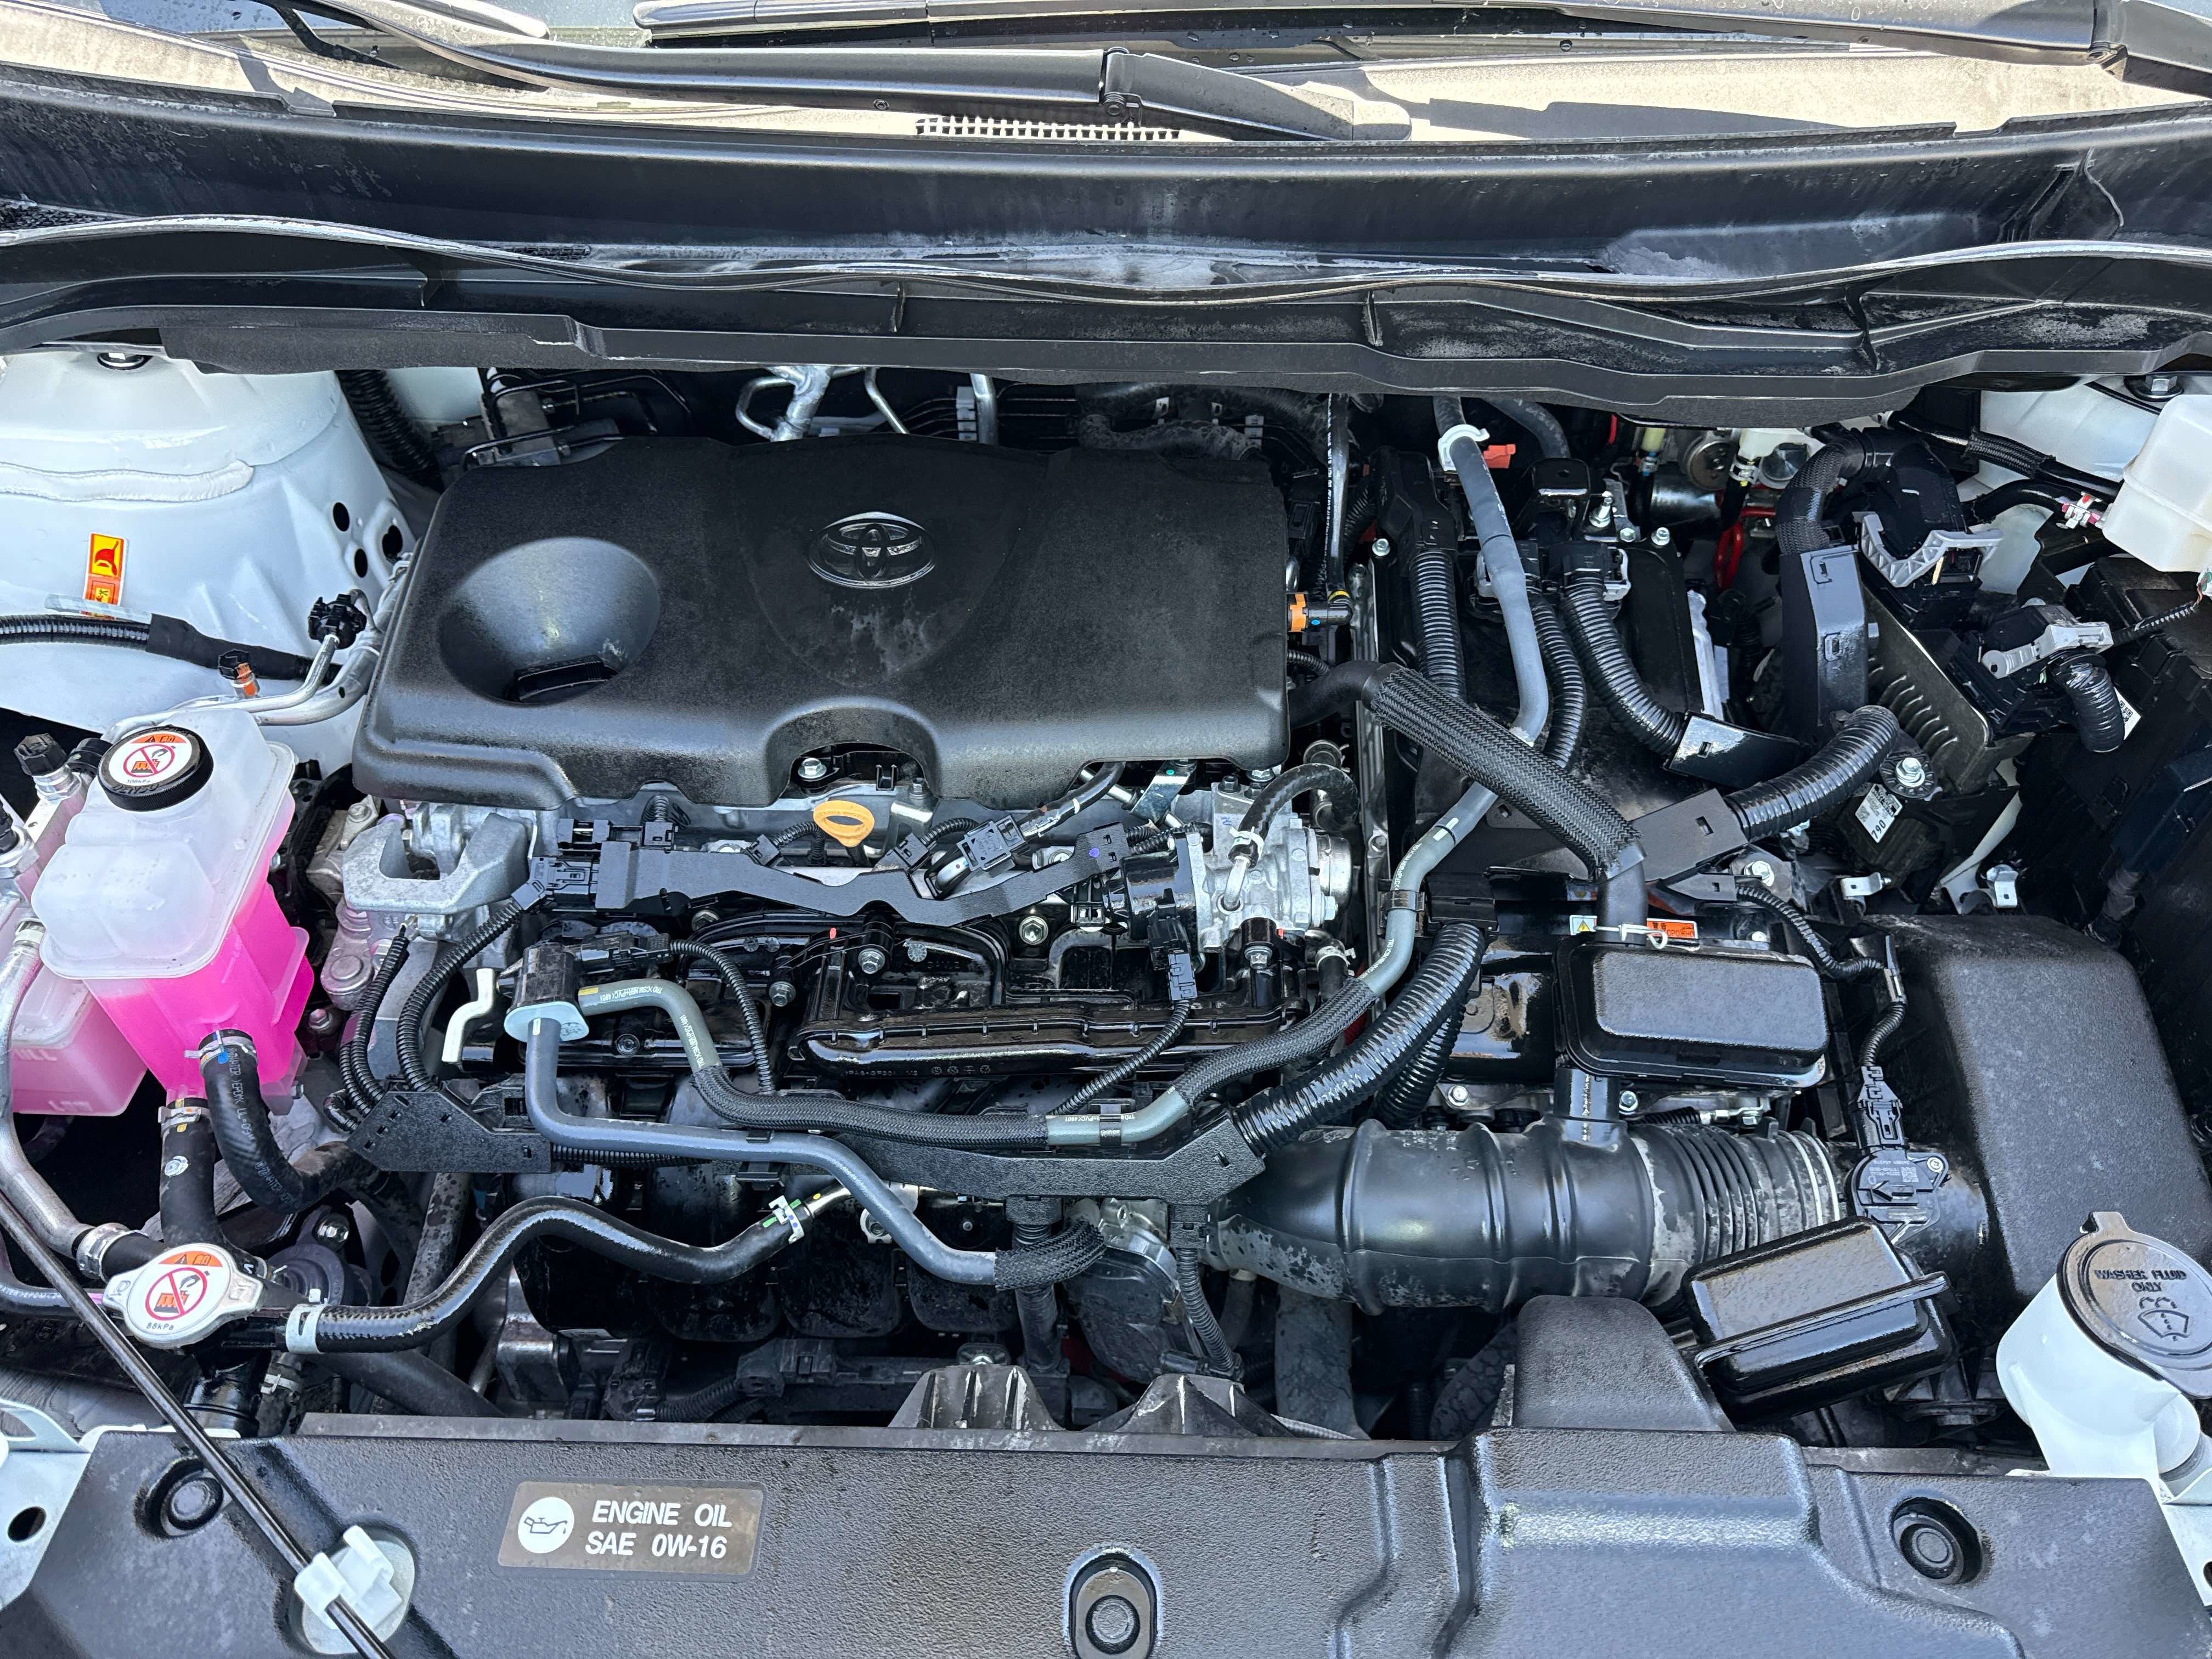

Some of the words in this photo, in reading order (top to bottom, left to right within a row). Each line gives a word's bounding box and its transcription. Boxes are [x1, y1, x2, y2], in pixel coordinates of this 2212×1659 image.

[112, 783, 159, 794] DENSO
[1871, 819, 1886, 839] 790
[2094, 1269, 2148, 1280] WASHER
[2151, 1269, 2187, 1280] FLUID
[2131, 1282, 2163, 1293] ONLY
[146, 1322, 174, 1331] 88kPa
[591, 1500, 681, 1526] ENGINE
[693, 1503, 733, 1528] OIL
[584, 1531, 637, 1556] SAE
[651, 1535, 727, 1559] 0W-16
